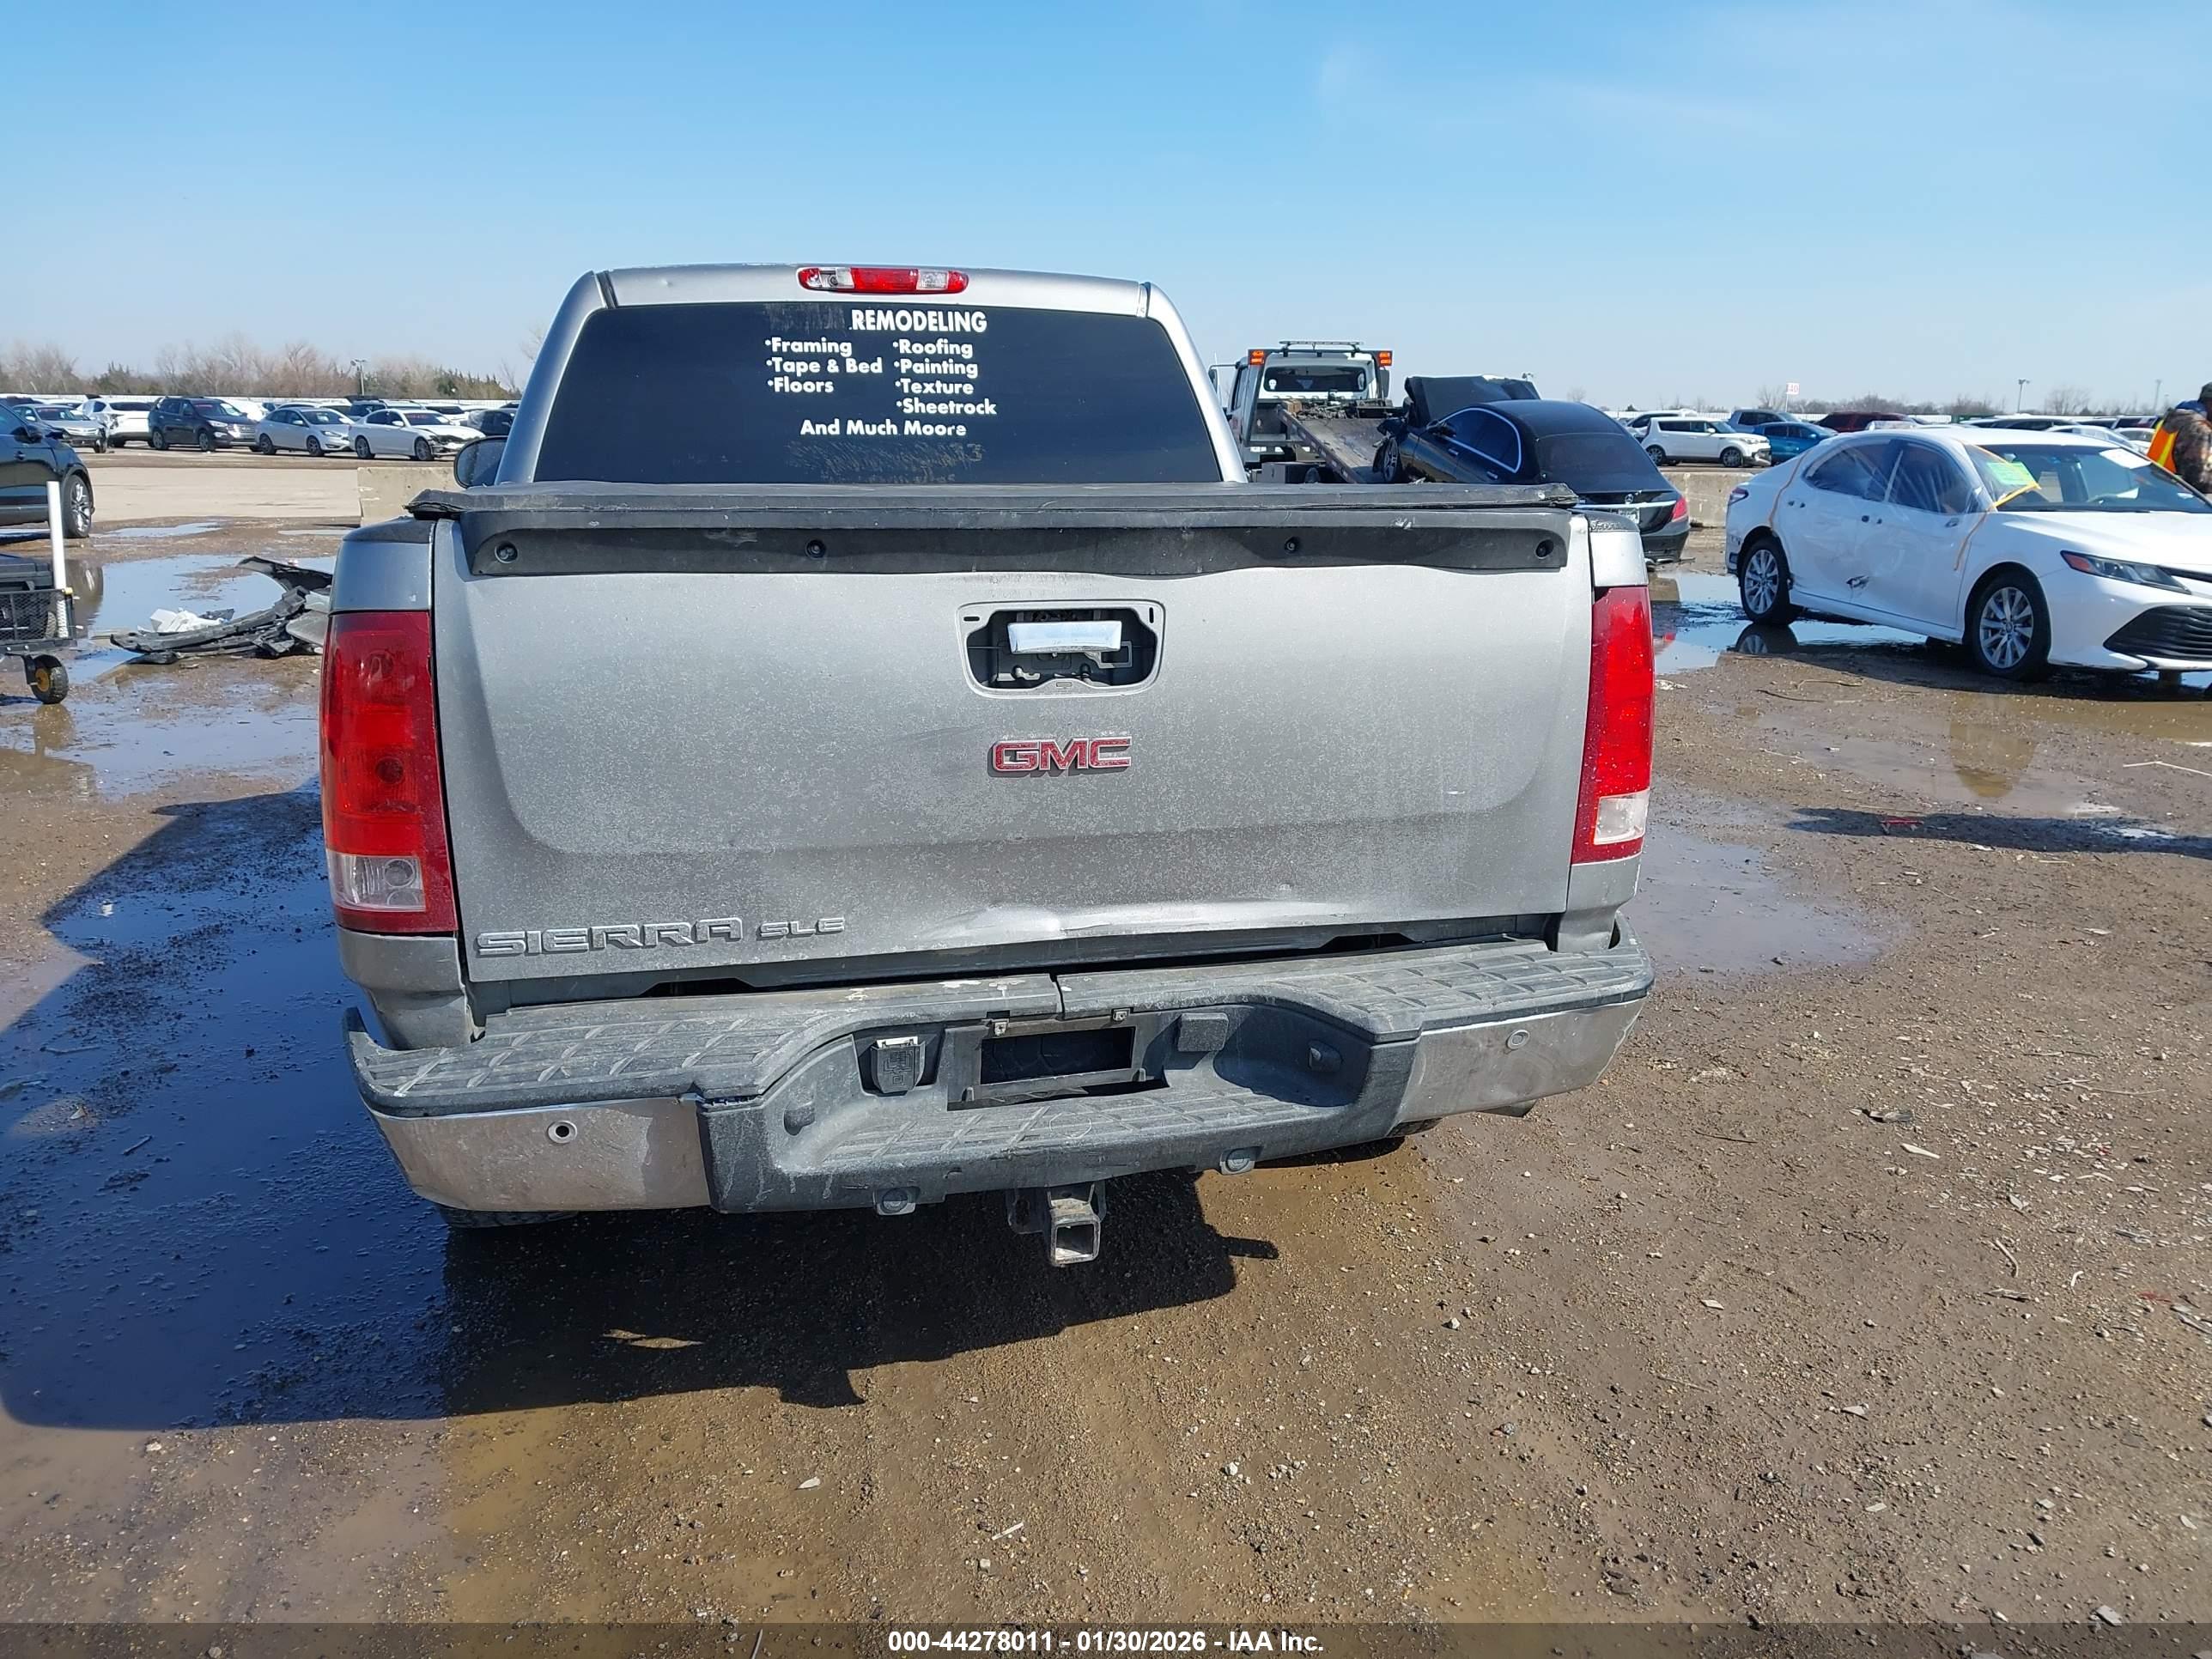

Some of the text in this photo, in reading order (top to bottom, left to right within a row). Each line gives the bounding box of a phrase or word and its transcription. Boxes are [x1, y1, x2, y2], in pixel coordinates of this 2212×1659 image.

[850, 309, 988, 333] REMODELING
[826, 358, 840, 374] &
[845, 356, 884, 374] Bed
[800, 418, 967, 436] And Much Moore
[992, 735, 1133, 773] GMC
[476, 916, 845, 957] SIERRA SLE
